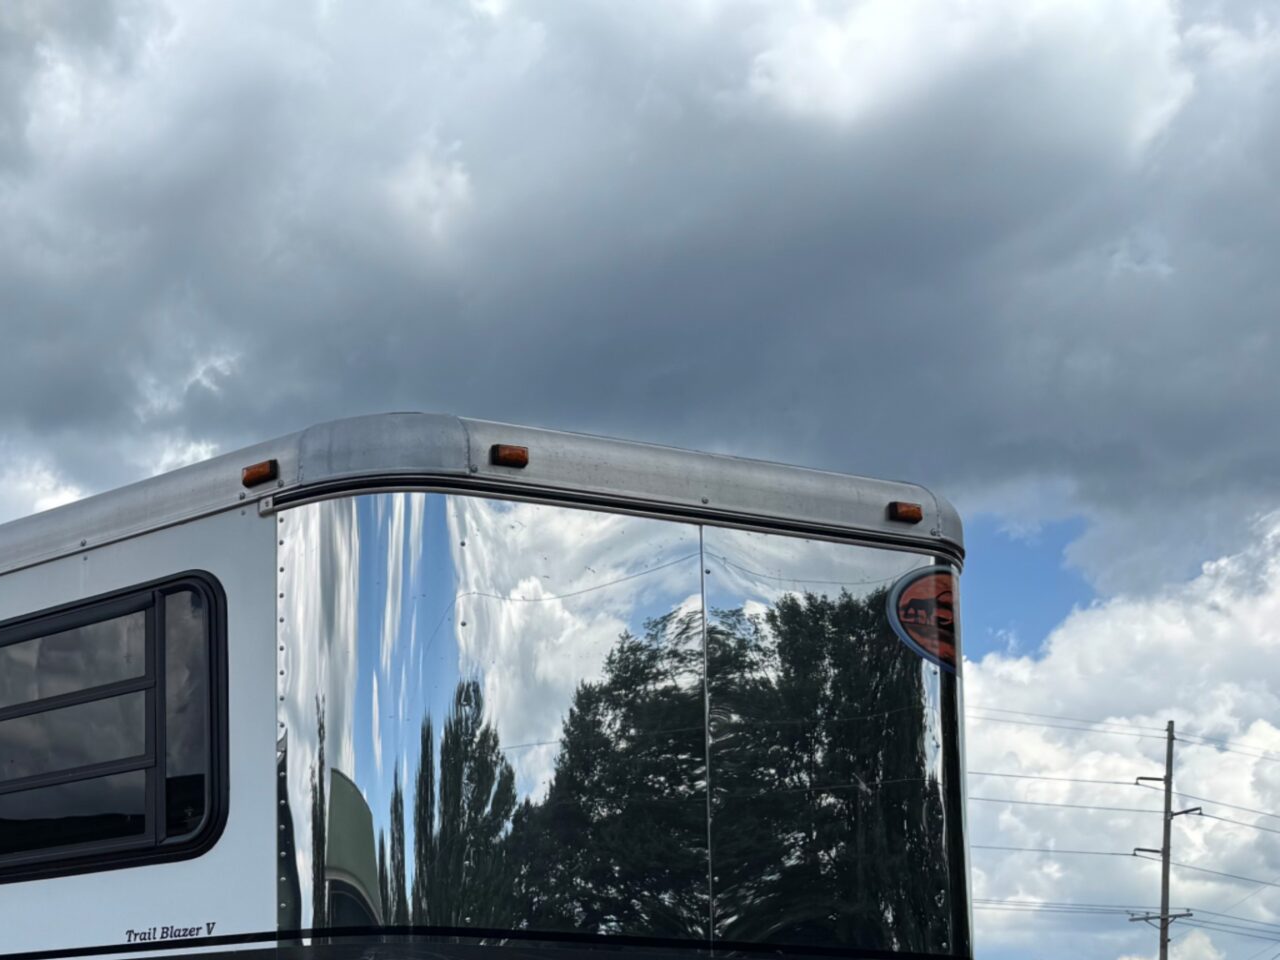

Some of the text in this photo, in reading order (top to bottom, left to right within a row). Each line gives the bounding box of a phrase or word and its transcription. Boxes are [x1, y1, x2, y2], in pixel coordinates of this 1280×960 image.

[125, 922, 216, 942] Trail Blazer V
